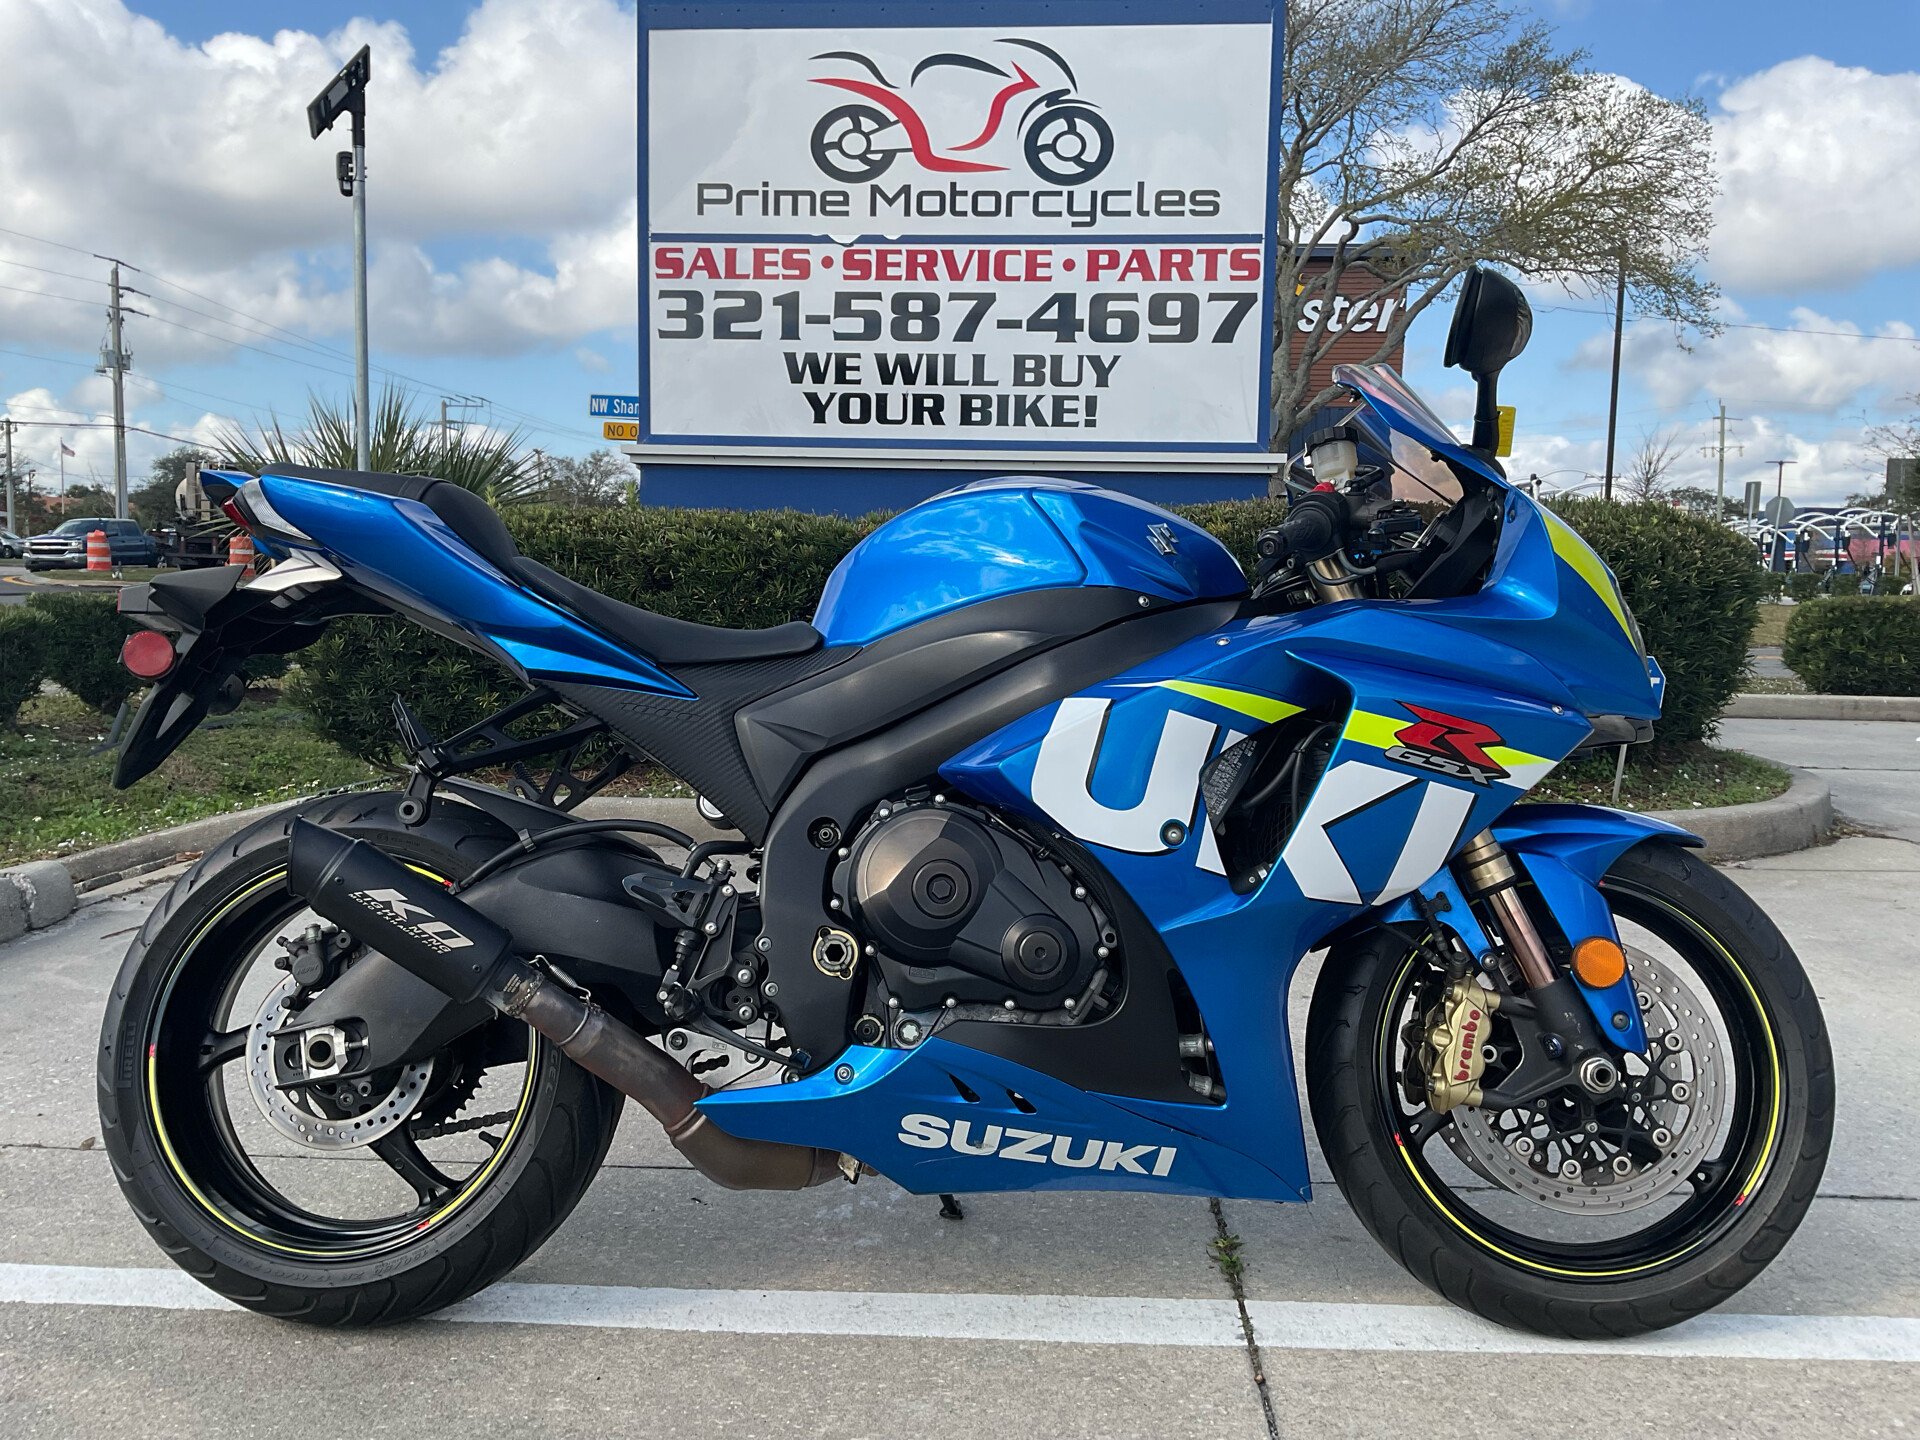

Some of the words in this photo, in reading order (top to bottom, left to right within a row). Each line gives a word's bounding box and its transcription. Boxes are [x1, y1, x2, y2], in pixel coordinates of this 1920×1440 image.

[697, 181, 850, 217] Prime
[870, 181, 1221, 228] Motorcycles
[655, 247, 811, 281] SALES
[842, 248, 1053, 282] SERVICE
[1086, 247, 1261, 282] PARTS
[657, 289, 1258, 344] 321-587-4697
[783, 351, 862, 386] WE
[873, 353, 1000, 387] WILL
[1012, 354, 1122, 388] BUY
[591, 398, 608, 413] NW
[802, 391, 946, 427] YOUR
[959, 394, 1098, 429] BIKE!
[607, 424, 624, 437] NO
[1384, 745, 1501, 786] GSX
[1454, 1009, 1481, 1081] brembo
[898, 1113, 1177, 1177] SUZUKI
